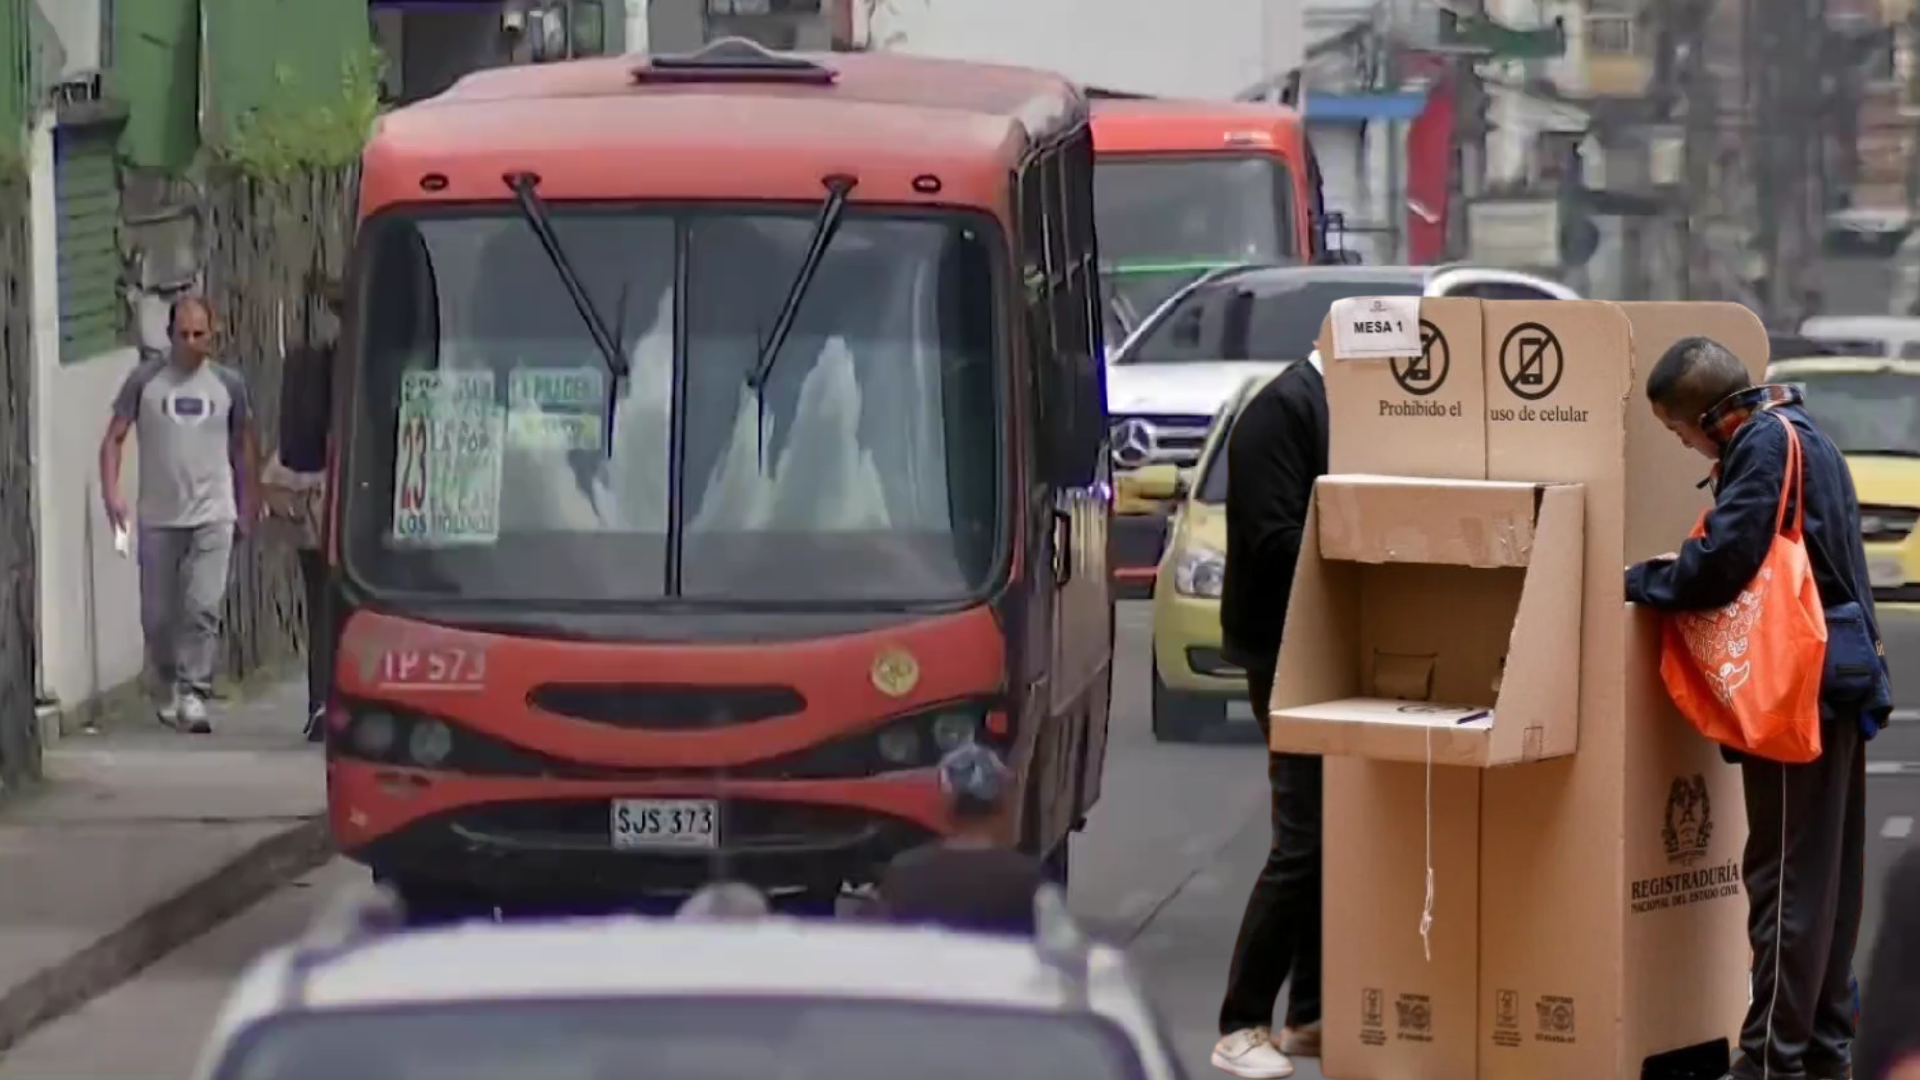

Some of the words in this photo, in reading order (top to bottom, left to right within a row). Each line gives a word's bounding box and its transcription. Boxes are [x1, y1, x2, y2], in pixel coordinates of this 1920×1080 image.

[1353, 321, 1393, 333] MESA
[1396, 320, 1404, 332] 1
[1378, 400, 1446, 416] Prohibido
[1449, 401, 1462, 417] el
[1490, 408, 1514, 421] uso
[1518, 405, 1535, 421] de
[1539, 406, 1589, 423] celular
[619, 806, 660, 834] SJS
[670, 807, 712, 834] 373
[1631, 858, 1739, 900] REGISTRADURÍA
[1689, 888, 1719, 902] ESTADO
[1720, 884, 1739, 897] CIVIL
